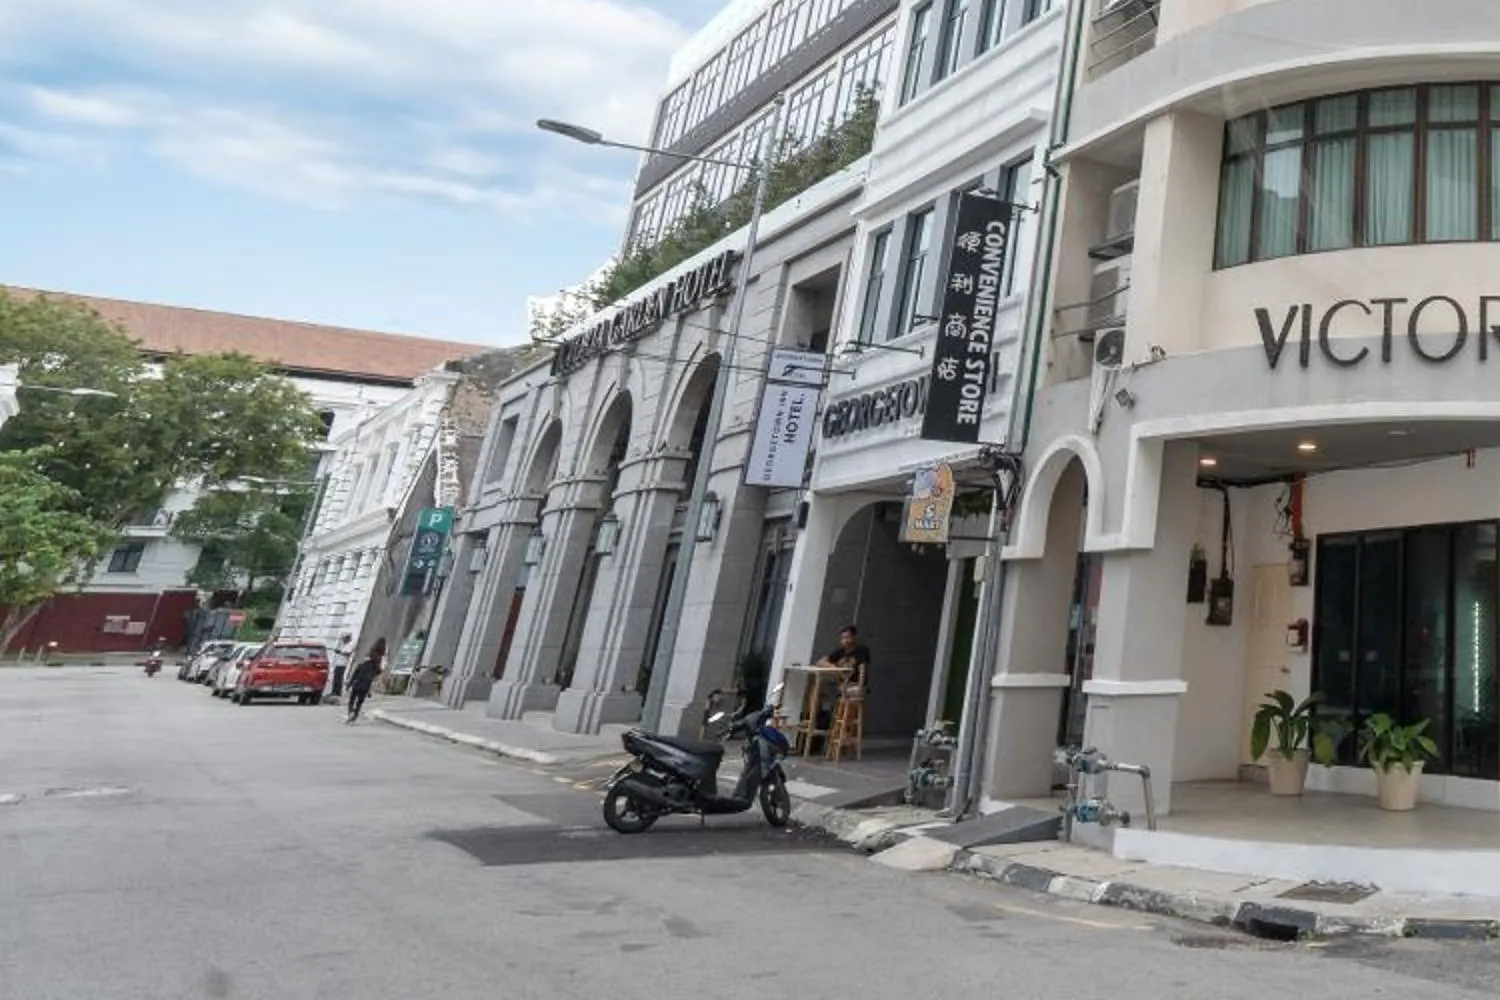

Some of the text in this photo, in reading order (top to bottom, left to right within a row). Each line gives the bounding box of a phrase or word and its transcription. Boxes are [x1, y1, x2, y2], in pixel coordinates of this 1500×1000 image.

[957, 220, 1006, 426] CONVENIENCE STORE
[428, 513, 443, 528] P
